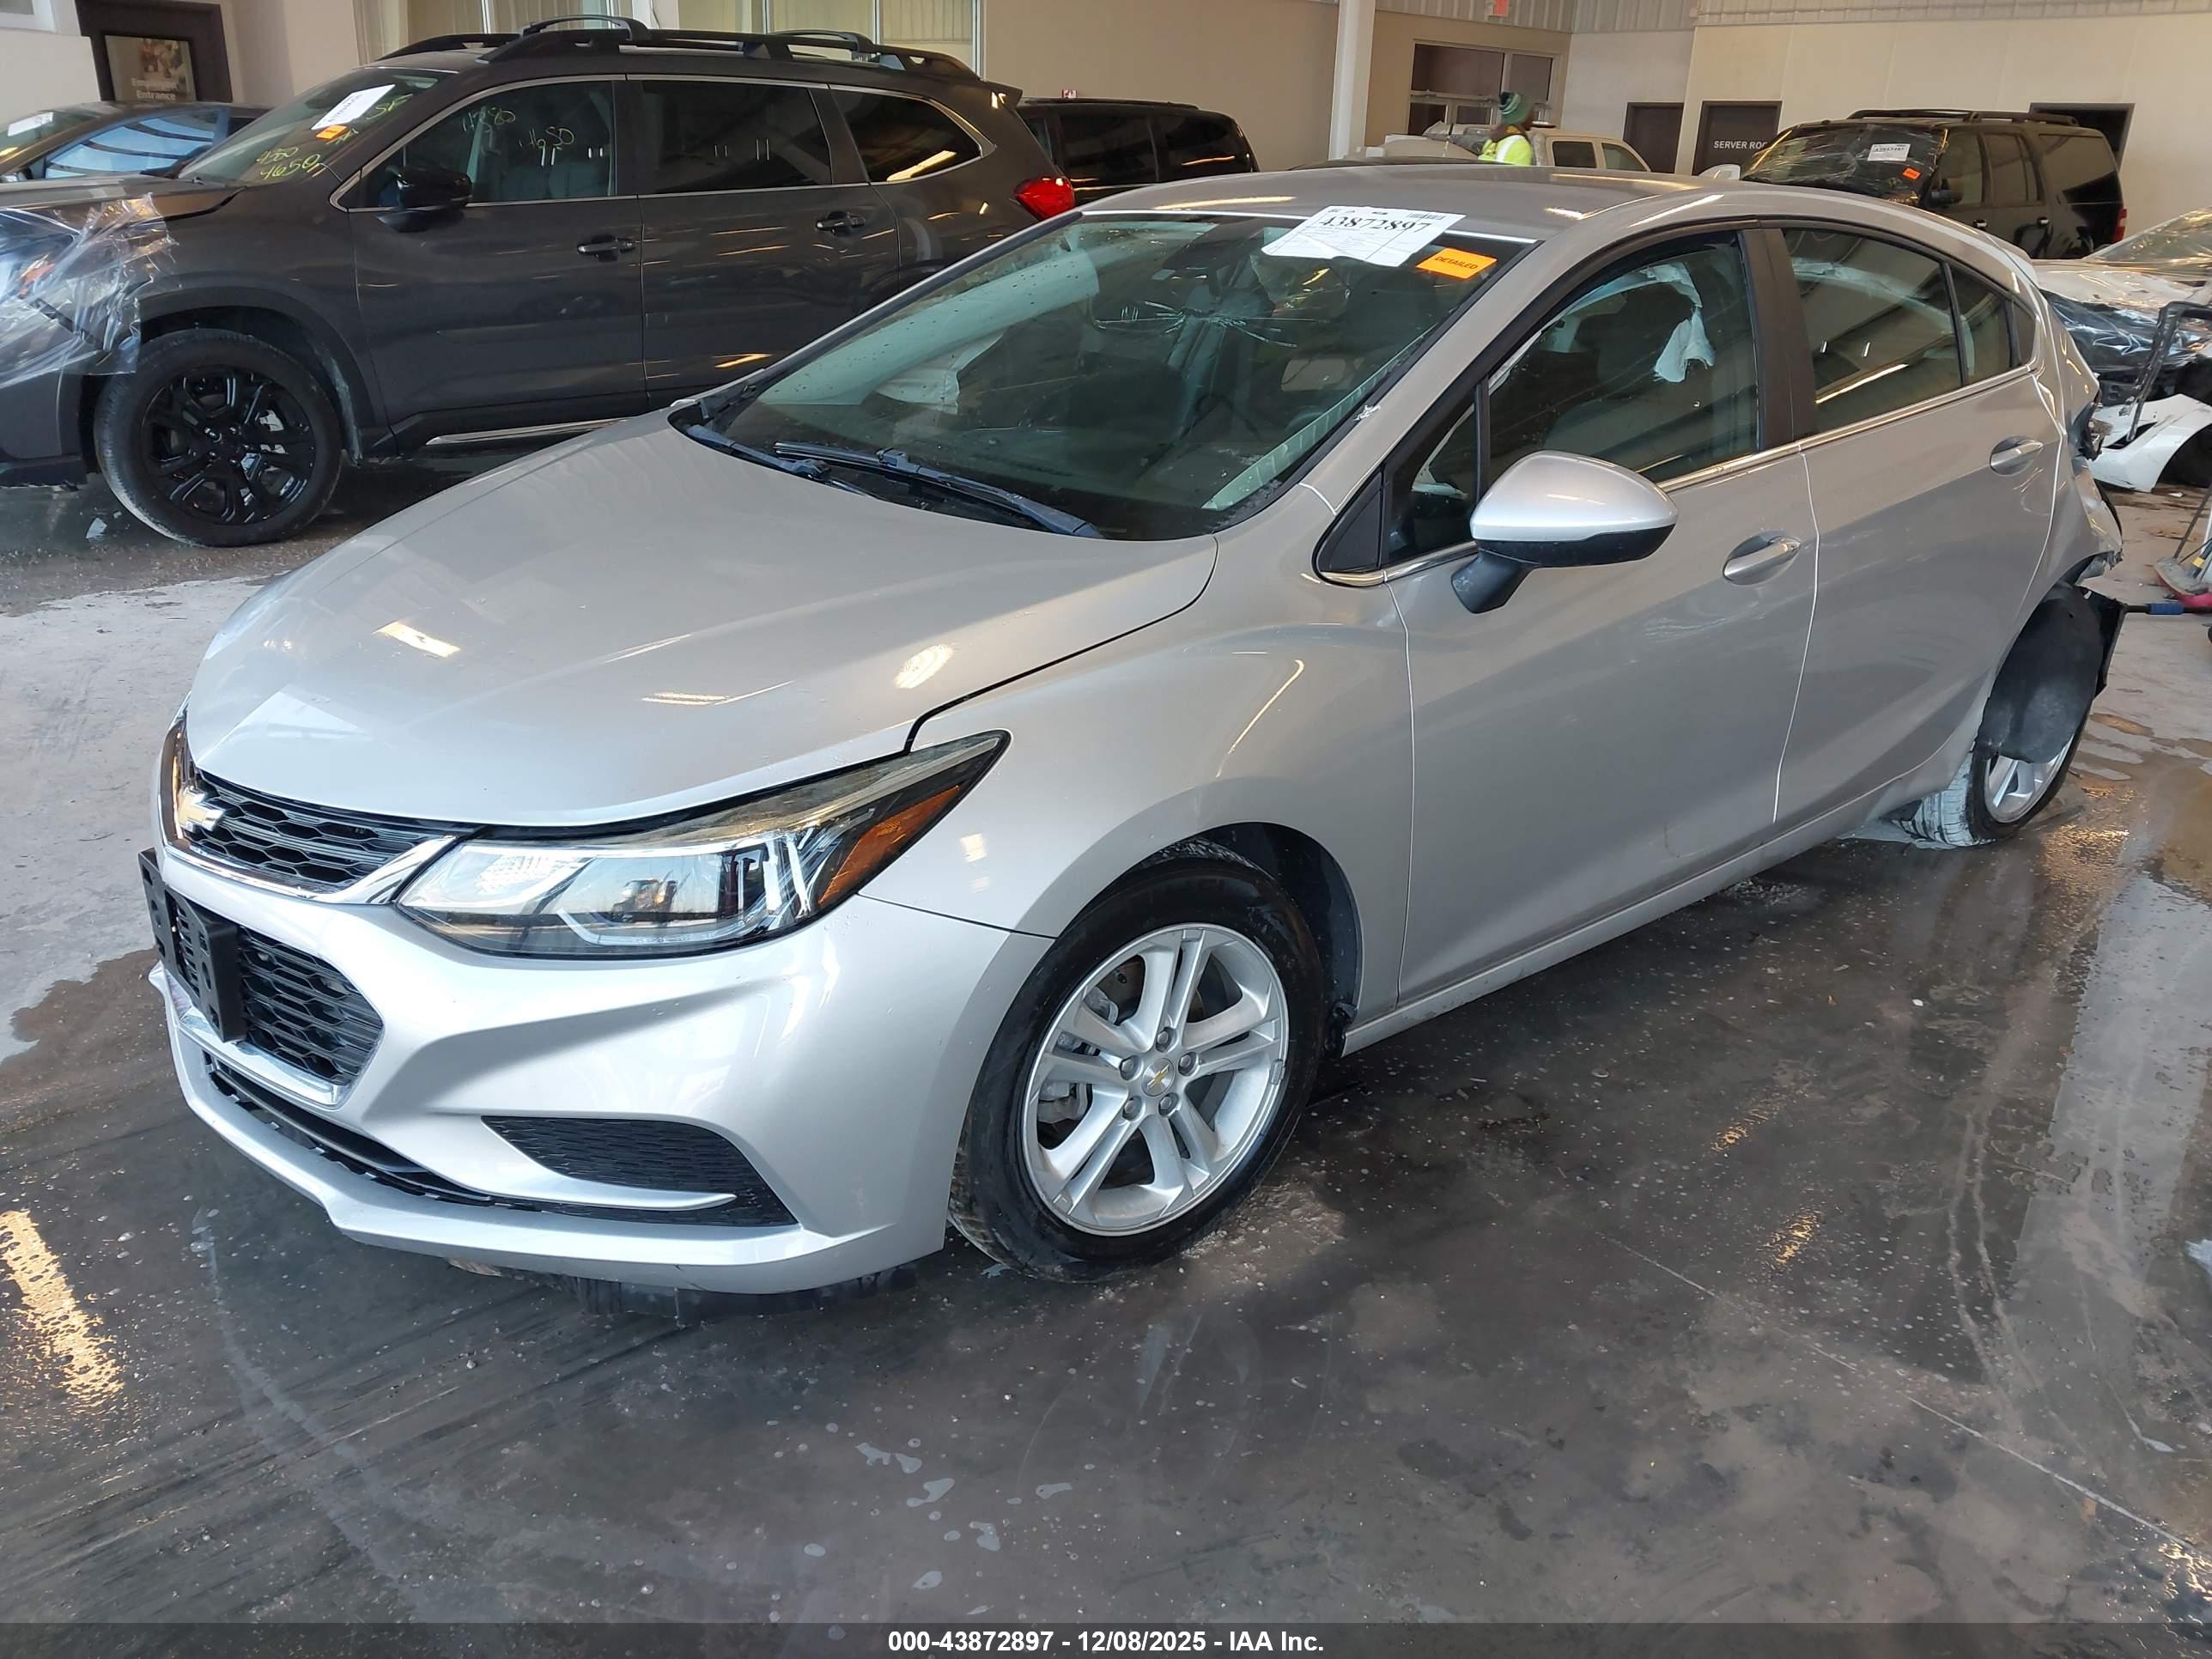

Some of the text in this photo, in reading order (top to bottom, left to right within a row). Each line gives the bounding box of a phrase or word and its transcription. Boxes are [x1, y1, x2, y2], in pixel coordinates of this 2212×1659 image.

[136, 89, 176, 101] Entrance
[1713, 140, 1747, 149] SERVER
[1319, 216, 1432, 234] 43872897
[1434, 256, 1479, 270] DETAILED
